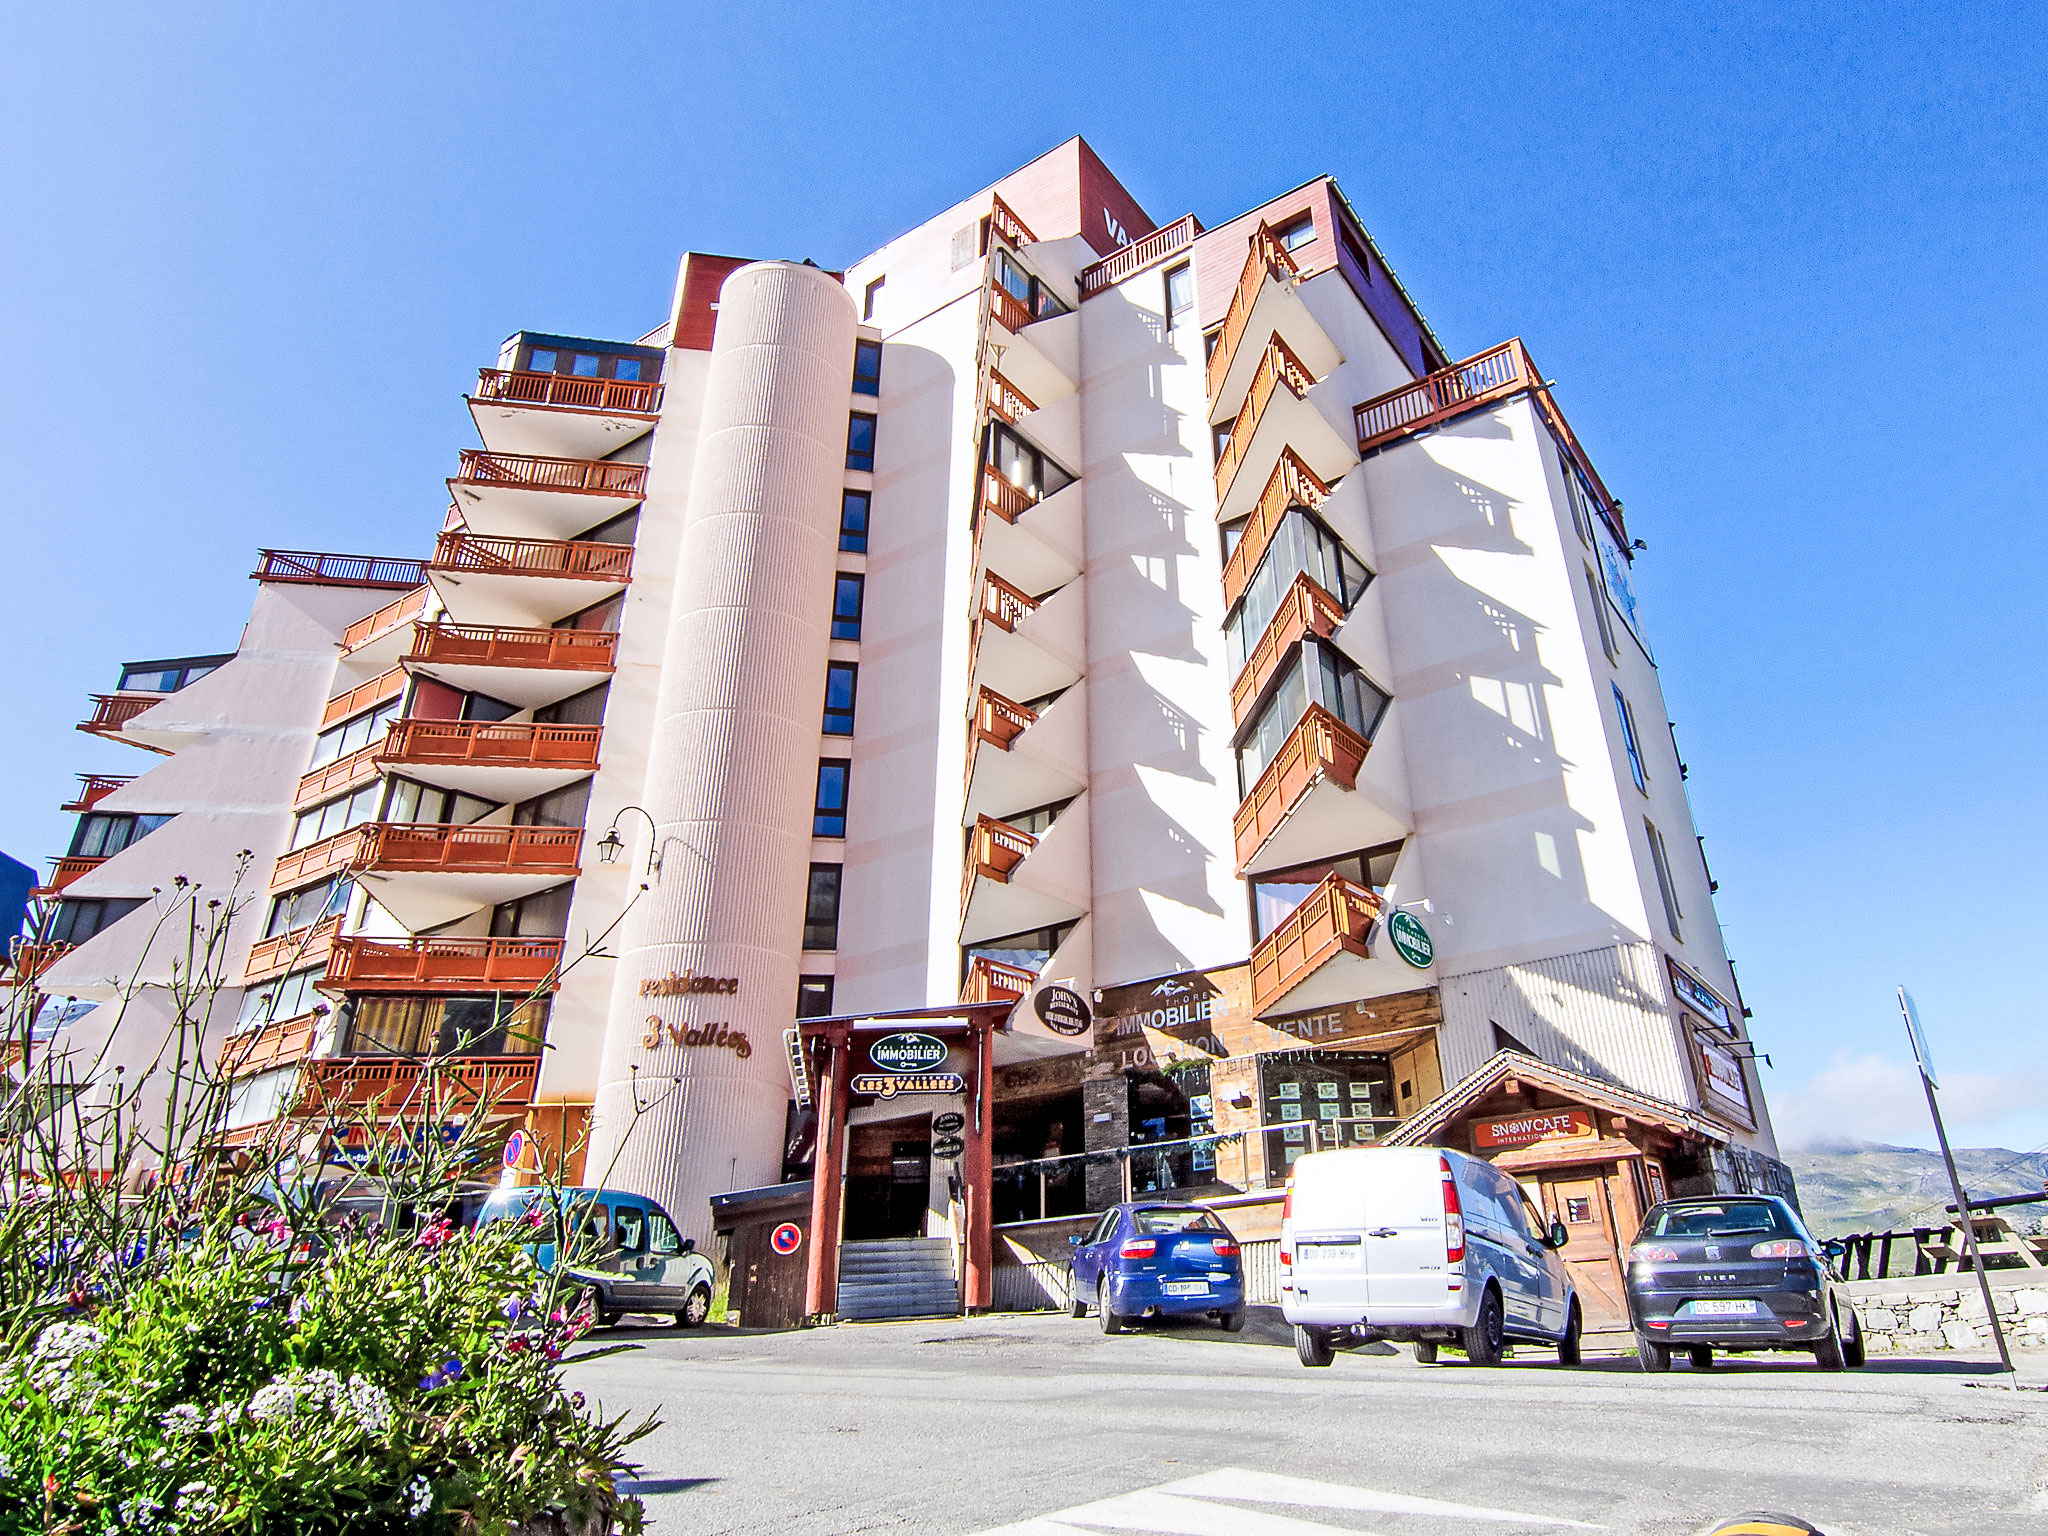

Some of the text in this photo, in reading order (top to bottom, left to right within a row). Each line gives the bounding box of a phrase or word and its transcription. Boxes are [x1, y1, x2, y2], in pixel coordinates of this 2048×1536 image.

[1103, 207, 1134, 246] VA
[642, 1015, 661, 1049] 3
[1116, 996, 1229, 1036] IMMOBILIER
[876, 1049, 941, 1061] IMMOBILIER
[1121, 1012, 1343, 1069] LOCATION VENTE
[859, 1081, 883, 1091] LES
[882, 1077, 896, 1096] 3
[1696, 1301, 1750, 1313] DC 597 HK
